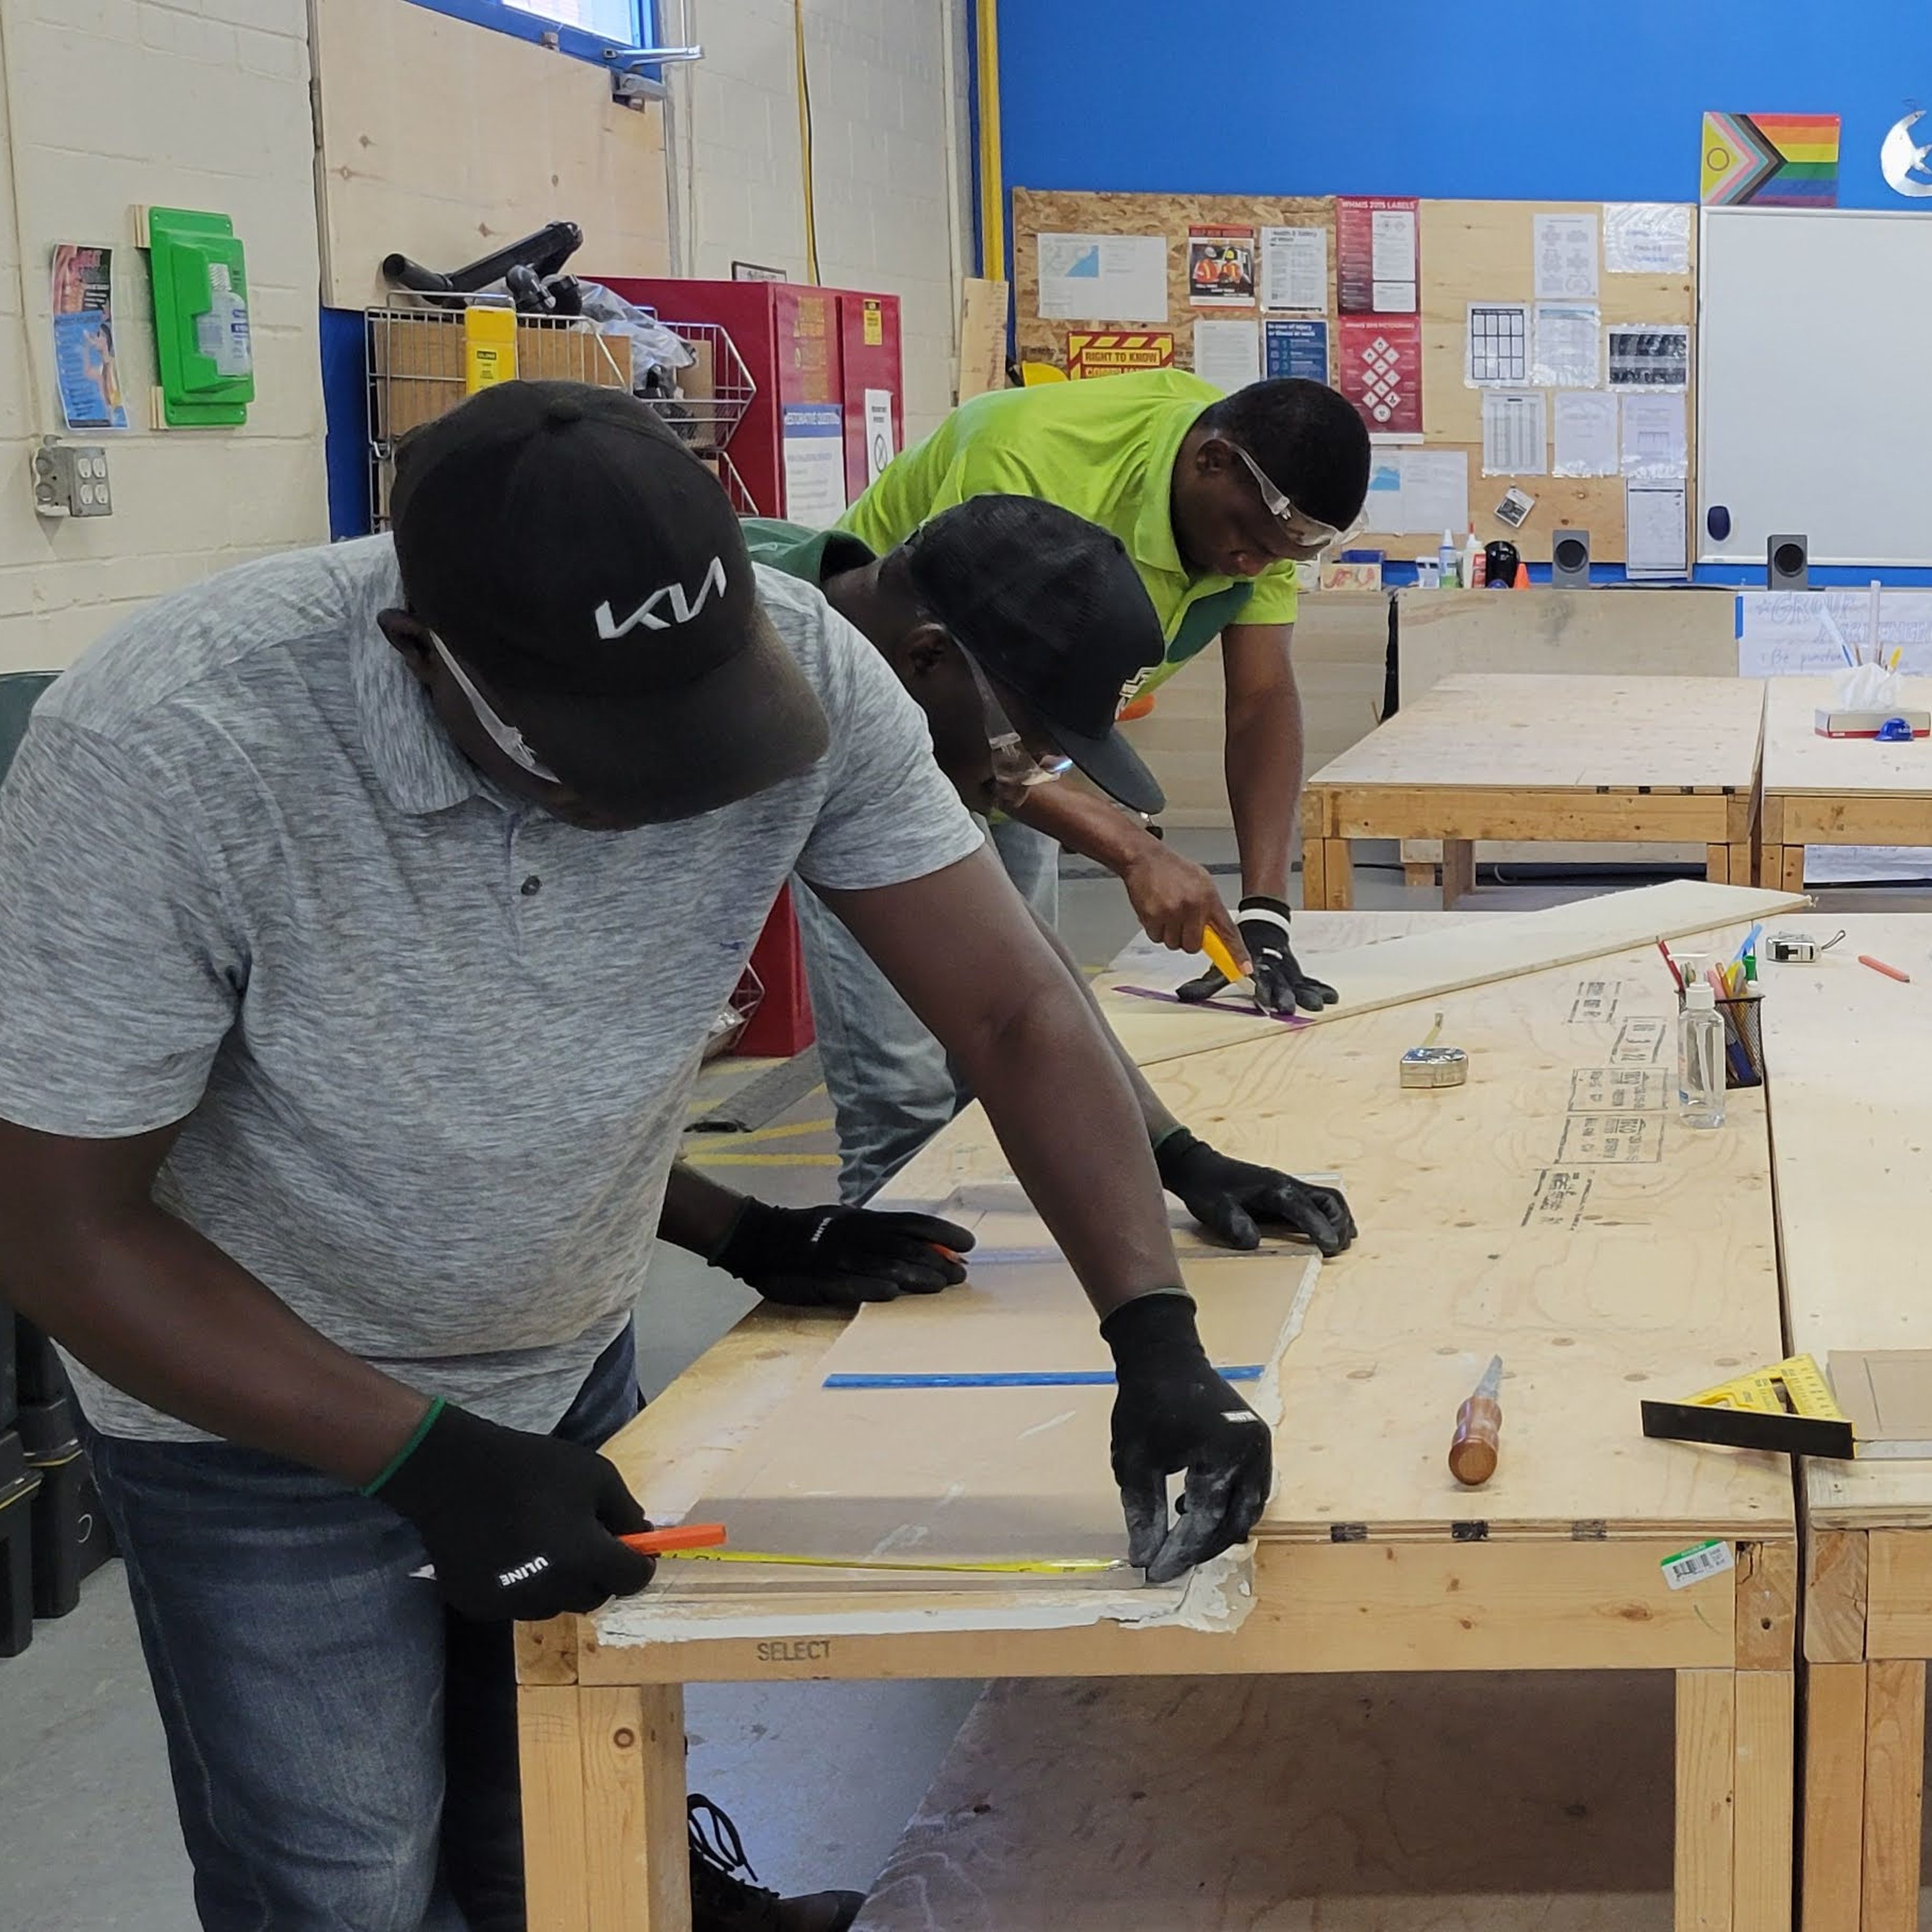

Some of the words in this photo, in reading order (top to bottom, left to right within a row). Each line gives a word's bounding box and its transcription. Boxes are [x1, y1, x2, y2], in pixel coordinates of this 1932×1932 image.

[1387, 201, 1415, 209] LABELS
[1085, 352, 1112, 362] RIGHT
[1115, 352, 1126, 362] TO
[1129, 352, 1157, 362] KNOW
[499, 1556, 548, 1586] ULINE
[757, 1639, 830, 1661] SELECT
